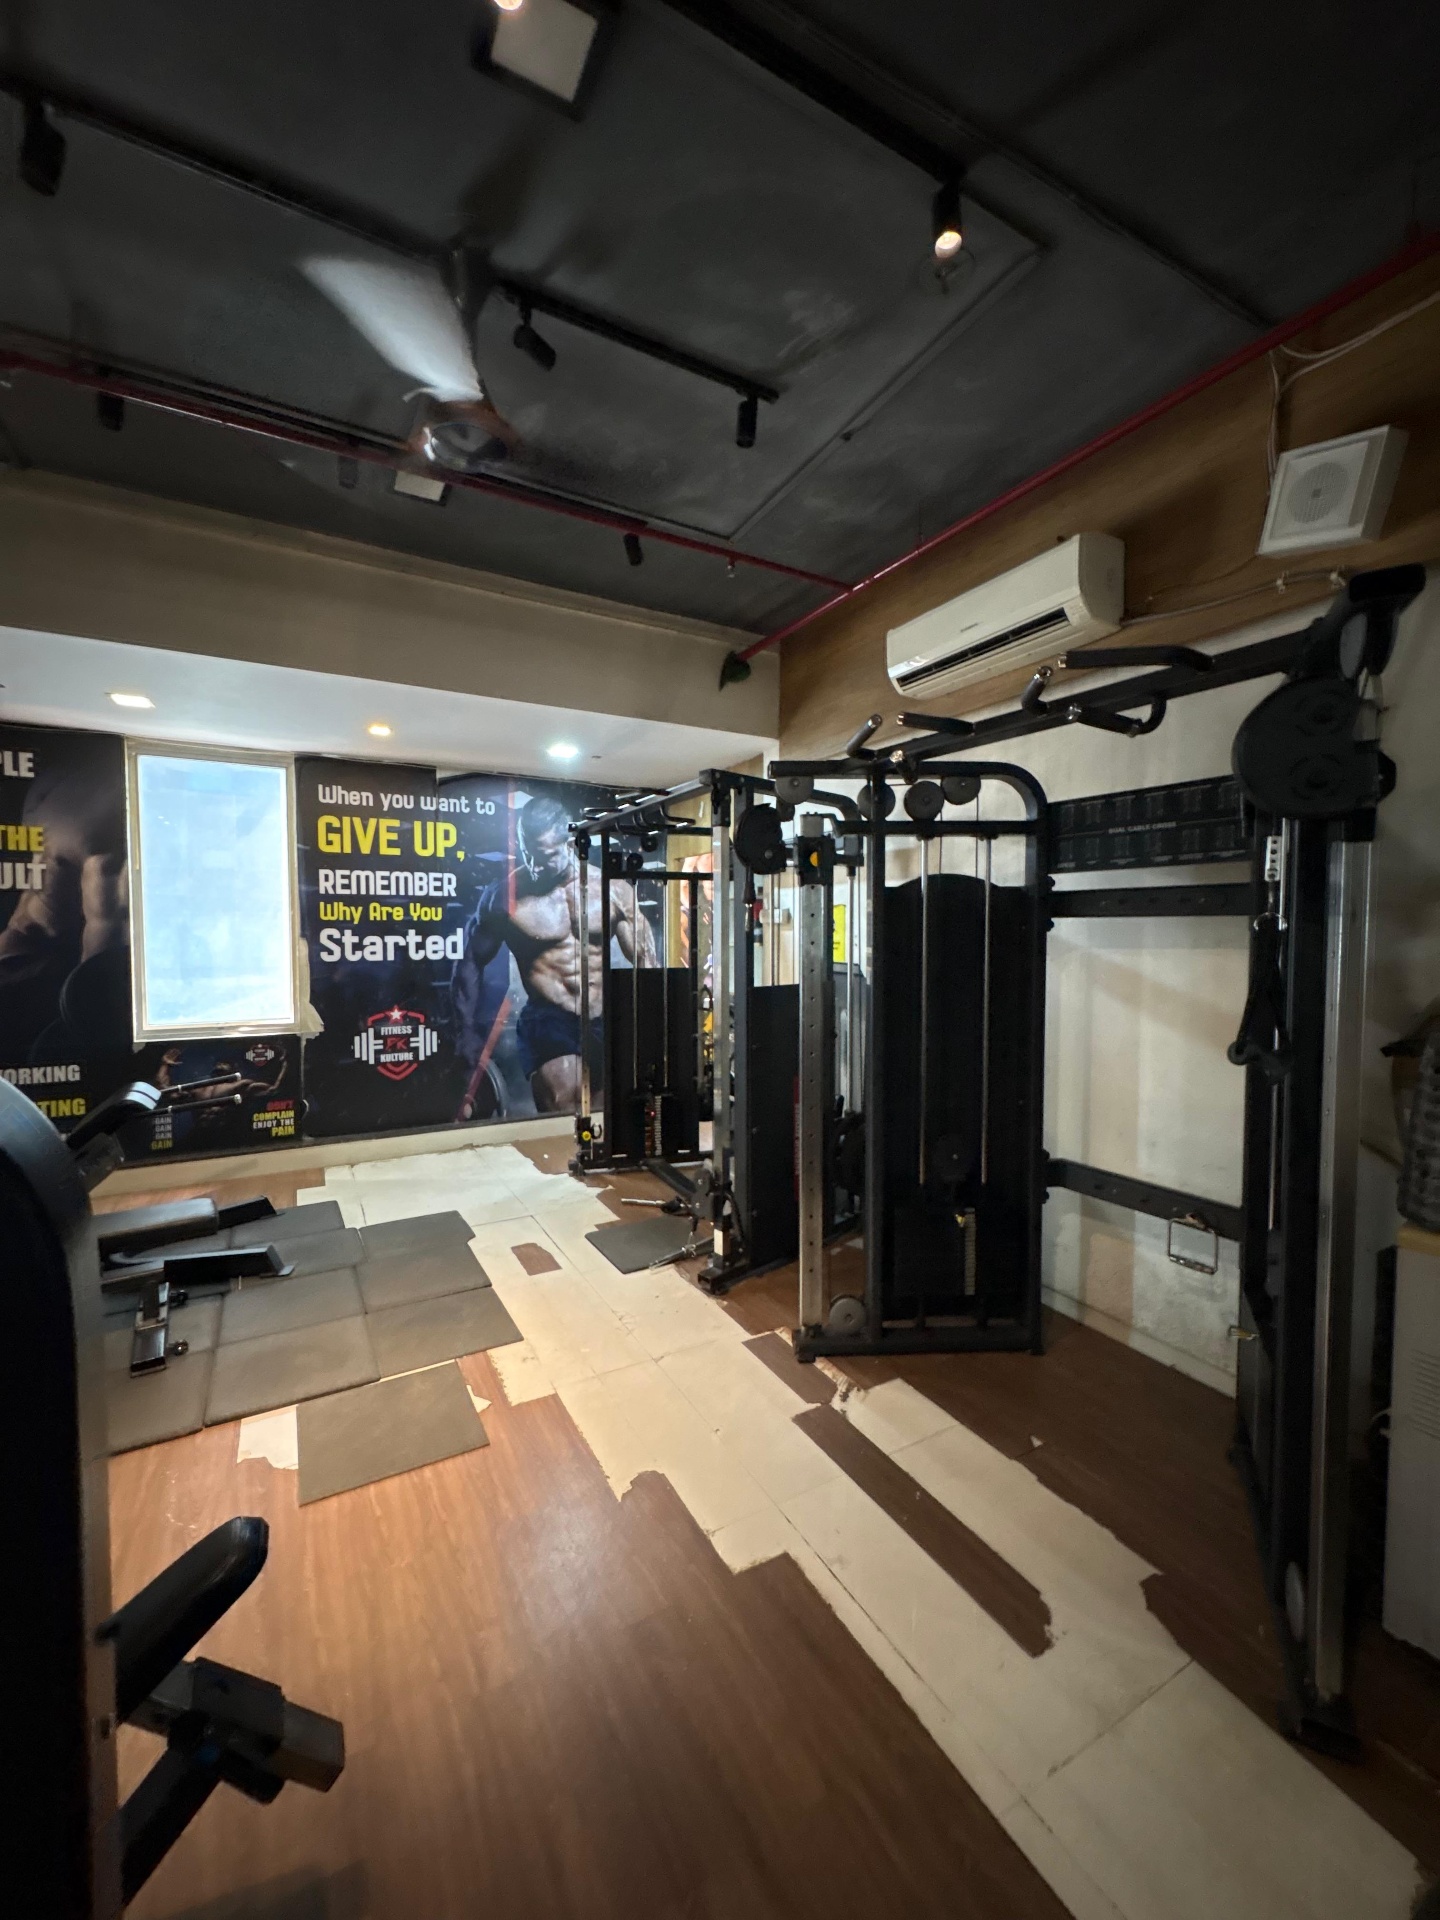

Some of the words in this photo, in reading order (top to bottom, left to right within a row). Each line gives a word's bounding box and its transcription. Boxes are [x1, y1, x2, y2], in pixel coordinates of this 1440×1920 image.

[0, 750, 35, 778] LE
[317, 783, 374, 807] When
[379, 792, 414, 812] you
[420, 795, 470, 813] want
[475, 796, 496, 816] to
[317, 814, 401, 856] GIVE
[413, 820, 465, 862] UP,
[318, 868, 457, 897] REMEMBER
[319, 901, 363, 925] Why
[369, 902, 404, 921] Are
[409, 902, 443, 921] You
[319, 927, 464, 962] Started
[380, 1025, 413, 1036] FITNESS
[380, 1052, 414, 1063] KULTURE
[0, 1064, 81, 1085] ORKING
[252, 1119, 277, 1129] ENJOY
[280, 1117, 295, 1127] THE
[253, 1109, 295, 1122] COMPLAIN
[271, 1125, 295, 1138] PAIN
[151, 1139, 173, 1150] GAIN
